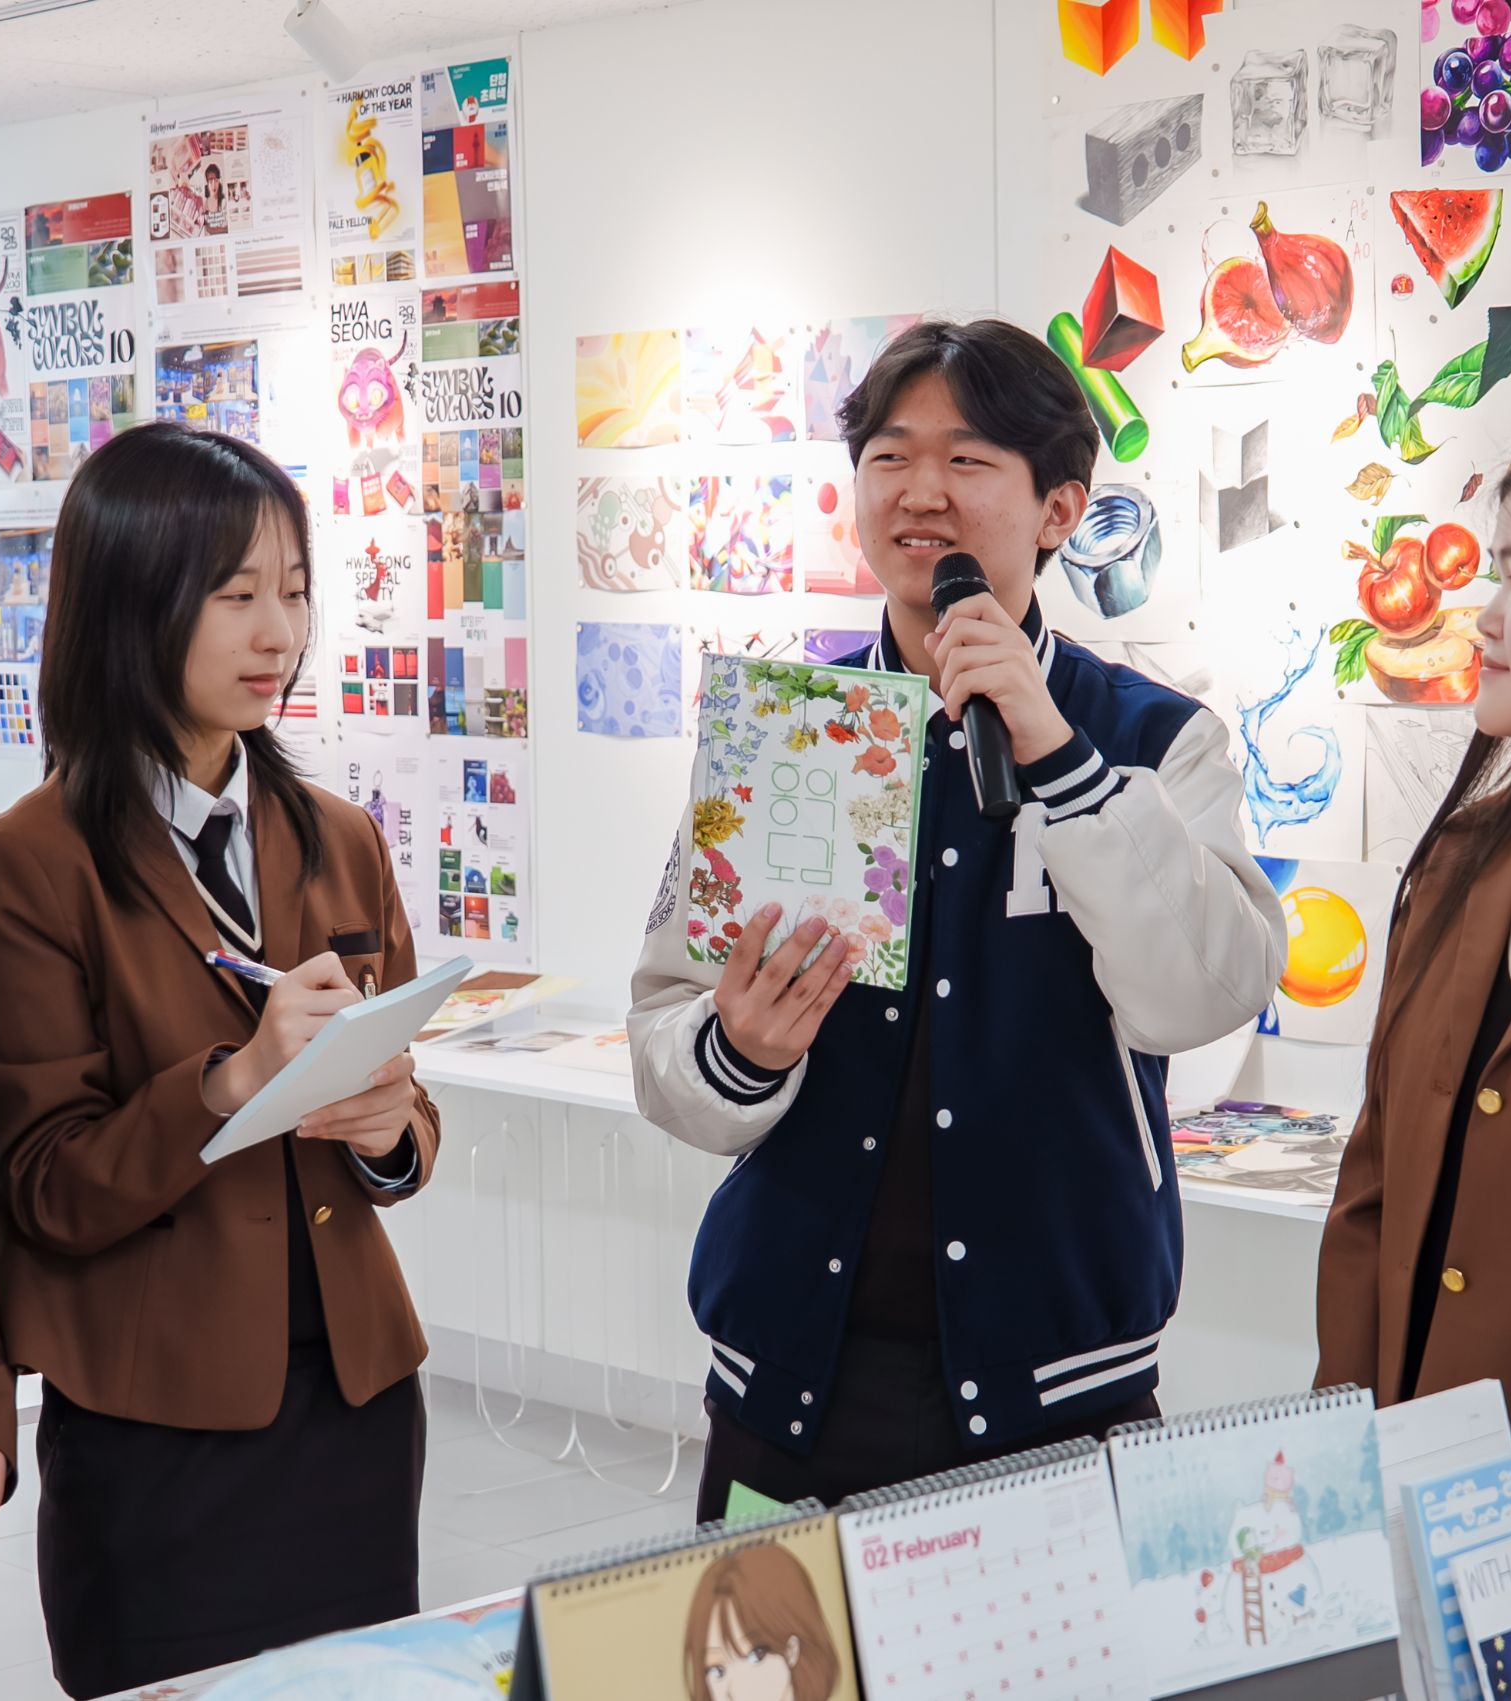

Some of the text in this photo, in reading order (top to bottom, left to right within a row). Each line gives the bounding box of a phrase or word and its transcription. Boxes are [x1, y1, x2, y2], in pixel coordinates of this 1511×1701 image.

[341, 82, 412, 104] HARMONY COLOR
[359, 97, 412, 116] OF THE YEAR
[328, 217, 345, 230] PALE
[27, 300, 104, 340] SYMBOL
[331, 300, 369, 322] HWA
[330, 318, 393, 343] SEONG
[32, 334, 105, 372] COLORS
[109, 328, 136, 364] 10
[422, 366, 494, 401] SYMBOL
[424, 394, 495, 424] COLORS
[499, 390, 523, 420] 10
[355, 570, 401, 586] SPEAL
[359, 586, 394, 601] CTY
[862, 1525, 982, 1571] 02 February
